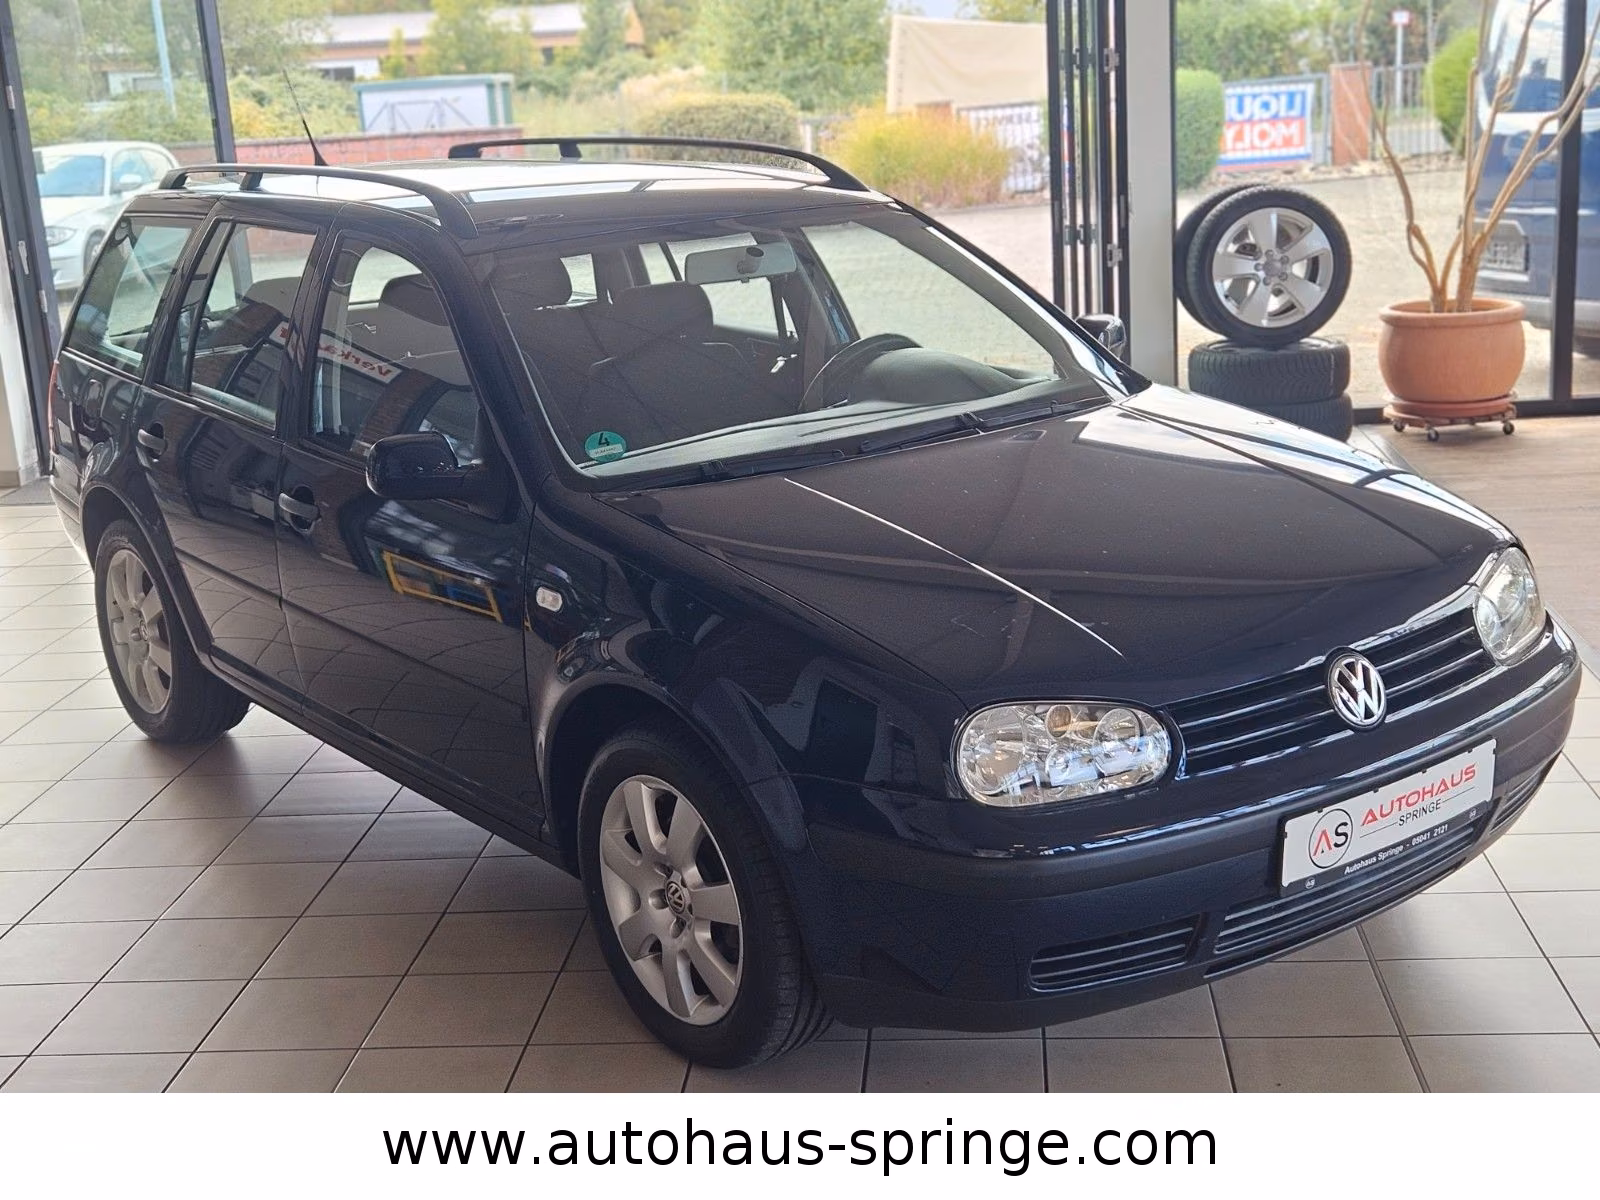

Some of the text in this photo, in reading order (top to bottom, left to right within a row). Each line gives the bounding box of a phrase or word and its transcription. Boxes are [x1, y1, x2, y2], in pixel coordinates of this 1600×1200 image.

[598, 432, 610, 446] 4
[1361, 763, 1477, 827] AUTOHAUS
[1398, 798, 1442, 827] SPRINGE
[1344, 857, 1377, 875] Autohaus
[1378, 844, 1404, 862] Springe
[1411, 831, 1431, 846] 05041
[1433, 824, 1449, 838] 2121
